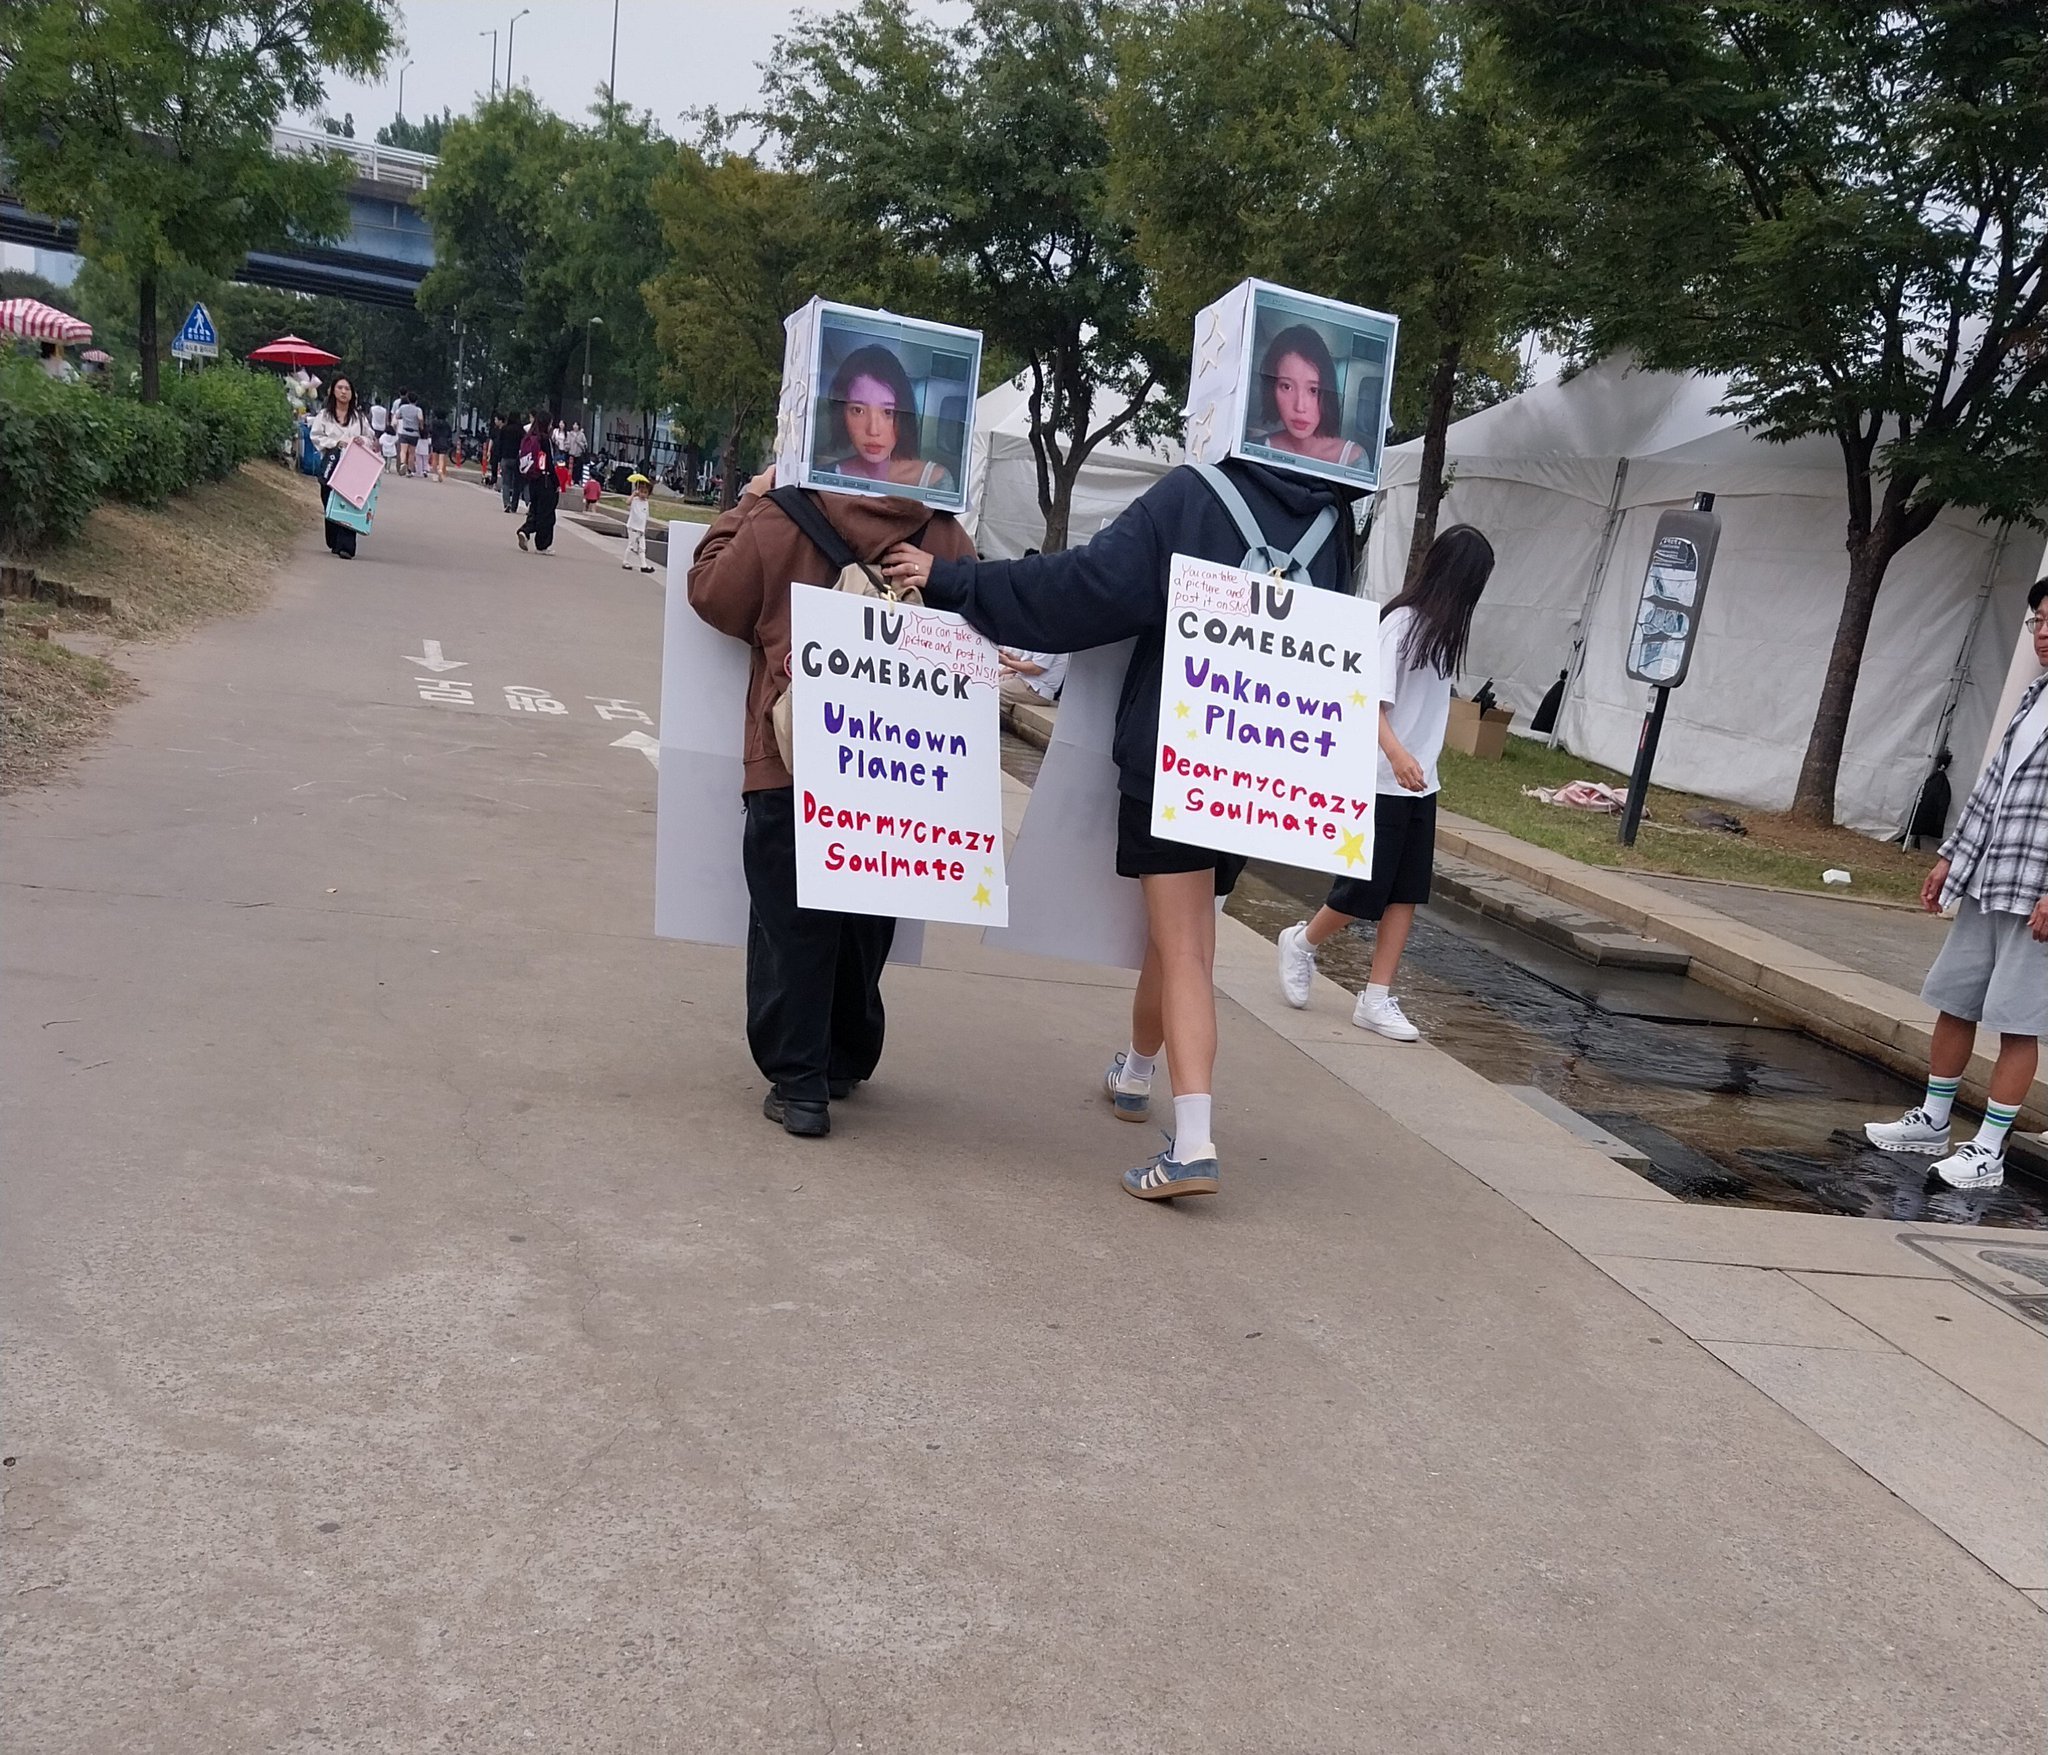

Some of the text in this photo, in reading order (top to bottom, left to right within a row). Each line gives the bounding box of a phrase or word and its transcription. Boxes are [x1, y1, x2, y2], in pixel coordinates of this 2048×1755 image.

[1174, 578, 1245, 598] a picture and
[1182, 563, 1200, 579] You
[1201, 570, 1217, 579] can
[1175, 592, 1200, 606] post
[1203, 595, 1212, 607] it
[1250, 582, 1293, 620] IU
[864, 607, 904, 644] IU
[916, 617, 932, 634] You
[935, 627, 950, 637] can
[953, 628, 972, 641] take
[1179, 612, 1361, 673] COMEBACK
[802, 641, 973, 699] COMEBACK
[935, 641, 952, 654] and
[956, 648, 975, 660] post
[977, 652, 985, 662] it
[414, 677, 655, 725] 보행로
[1185, 656, 1341, 721] Unknown
[824, 702, 966, 756] Unknown
[1206, 705, 1336, 757] Planet
[839, 745, 948, 791] Planet
[1186, 788, 1336, 839] Soulmate
[825, 843, 964, 880] Soulmate
